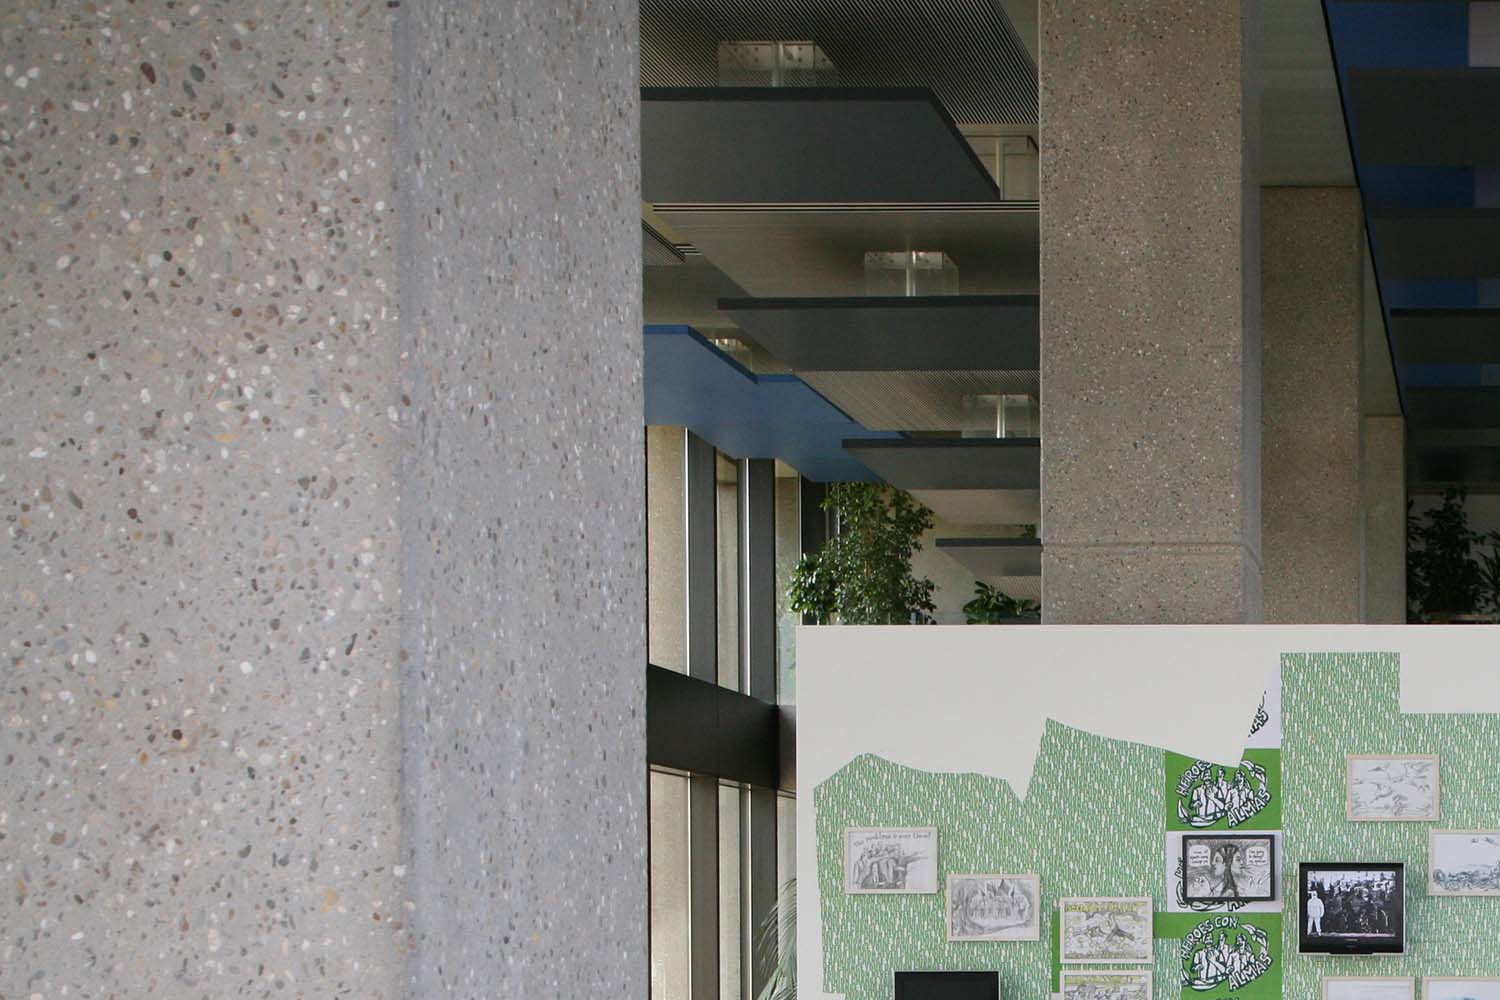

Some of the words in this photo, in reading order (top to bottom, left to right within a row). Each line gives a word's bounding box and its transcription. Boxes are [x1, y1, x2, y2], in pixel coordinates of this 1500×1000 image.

[1226, 789, 1272, 828] ALMAS
[1214, 915, 1239, 929] CON
[1228, 953, 1273, 992] ALMAS
